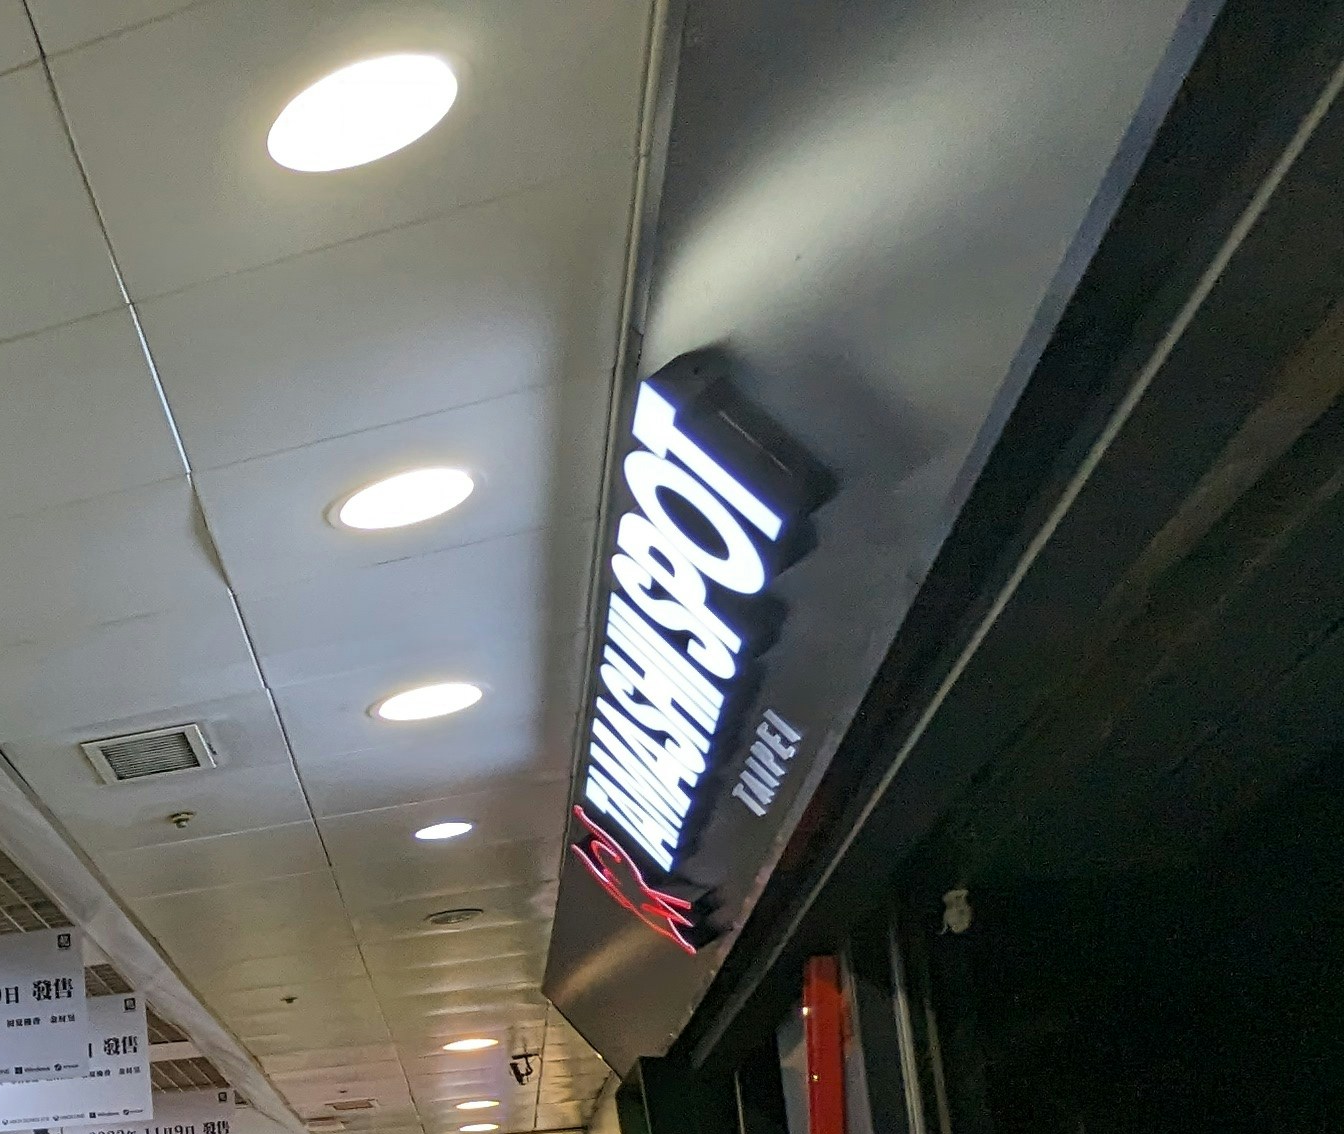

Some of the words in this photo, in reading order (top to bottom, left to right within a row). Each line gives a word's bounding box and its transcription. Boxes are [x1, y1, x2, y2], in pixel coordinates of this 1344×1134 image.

[611, 380, 783, 681] SPOT
[585, 592, 724, 873] TAMASHII
[732, 708, 802, 817] TAIPEI
[32, 977, 74, 1001] 發售
